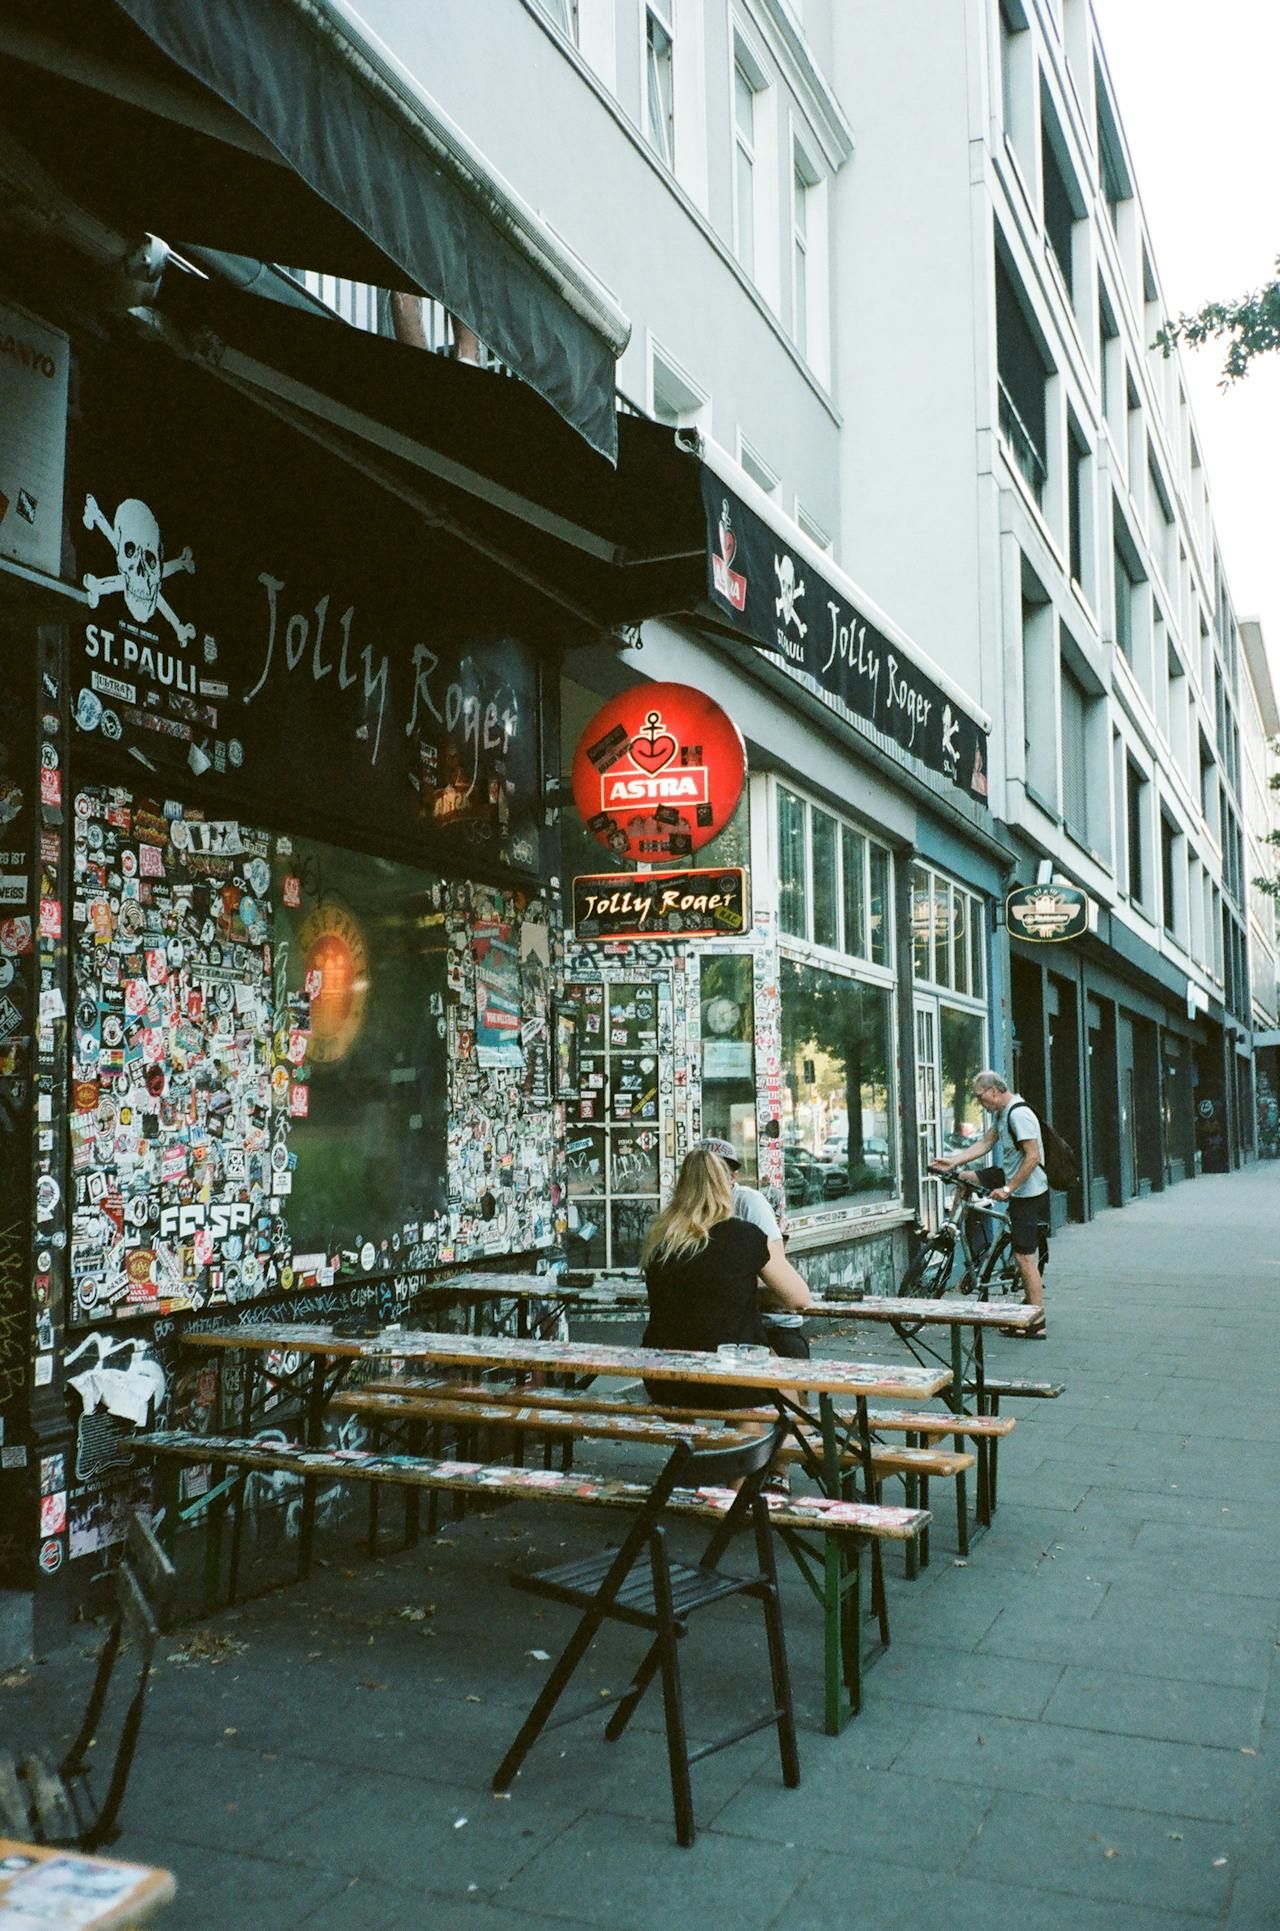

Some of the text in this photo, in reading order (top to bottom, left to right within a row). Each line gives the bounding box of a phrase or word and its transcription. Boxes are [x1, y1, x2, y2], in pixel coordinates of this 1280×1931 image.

[85, 624, 118, 666] ST.
[124, 639, 196, 694] PAULI
[243, 572, 518, 799] Jolly Roger
[822, 601, 931, 747] Jolly Roger
[609, 776, 698, 800] ASTRA
[584, 891, 652, 924] Jolly
